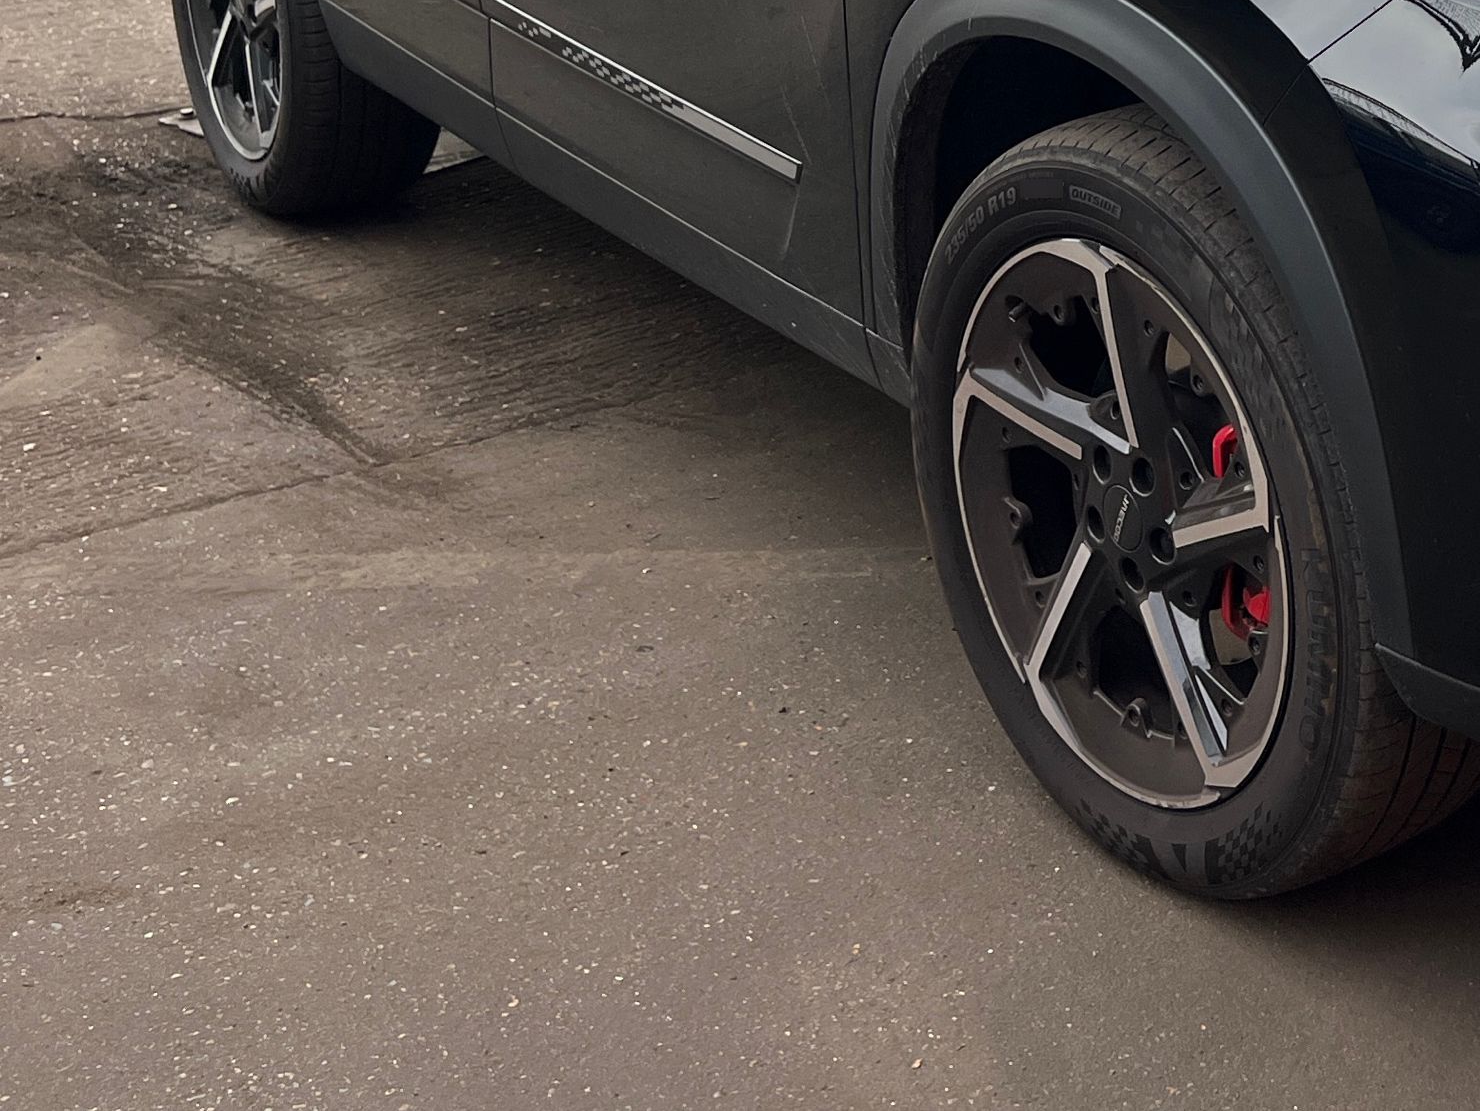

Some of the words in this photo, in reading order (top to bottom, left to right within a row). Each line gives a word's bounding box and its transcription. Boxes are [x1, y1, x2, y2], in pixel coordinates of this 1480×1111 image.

[944, 205, 985, 263] 235/50
[987, 186, 1018, 216] R19
[1070, 186, 1121, 218] OUTSIDE
